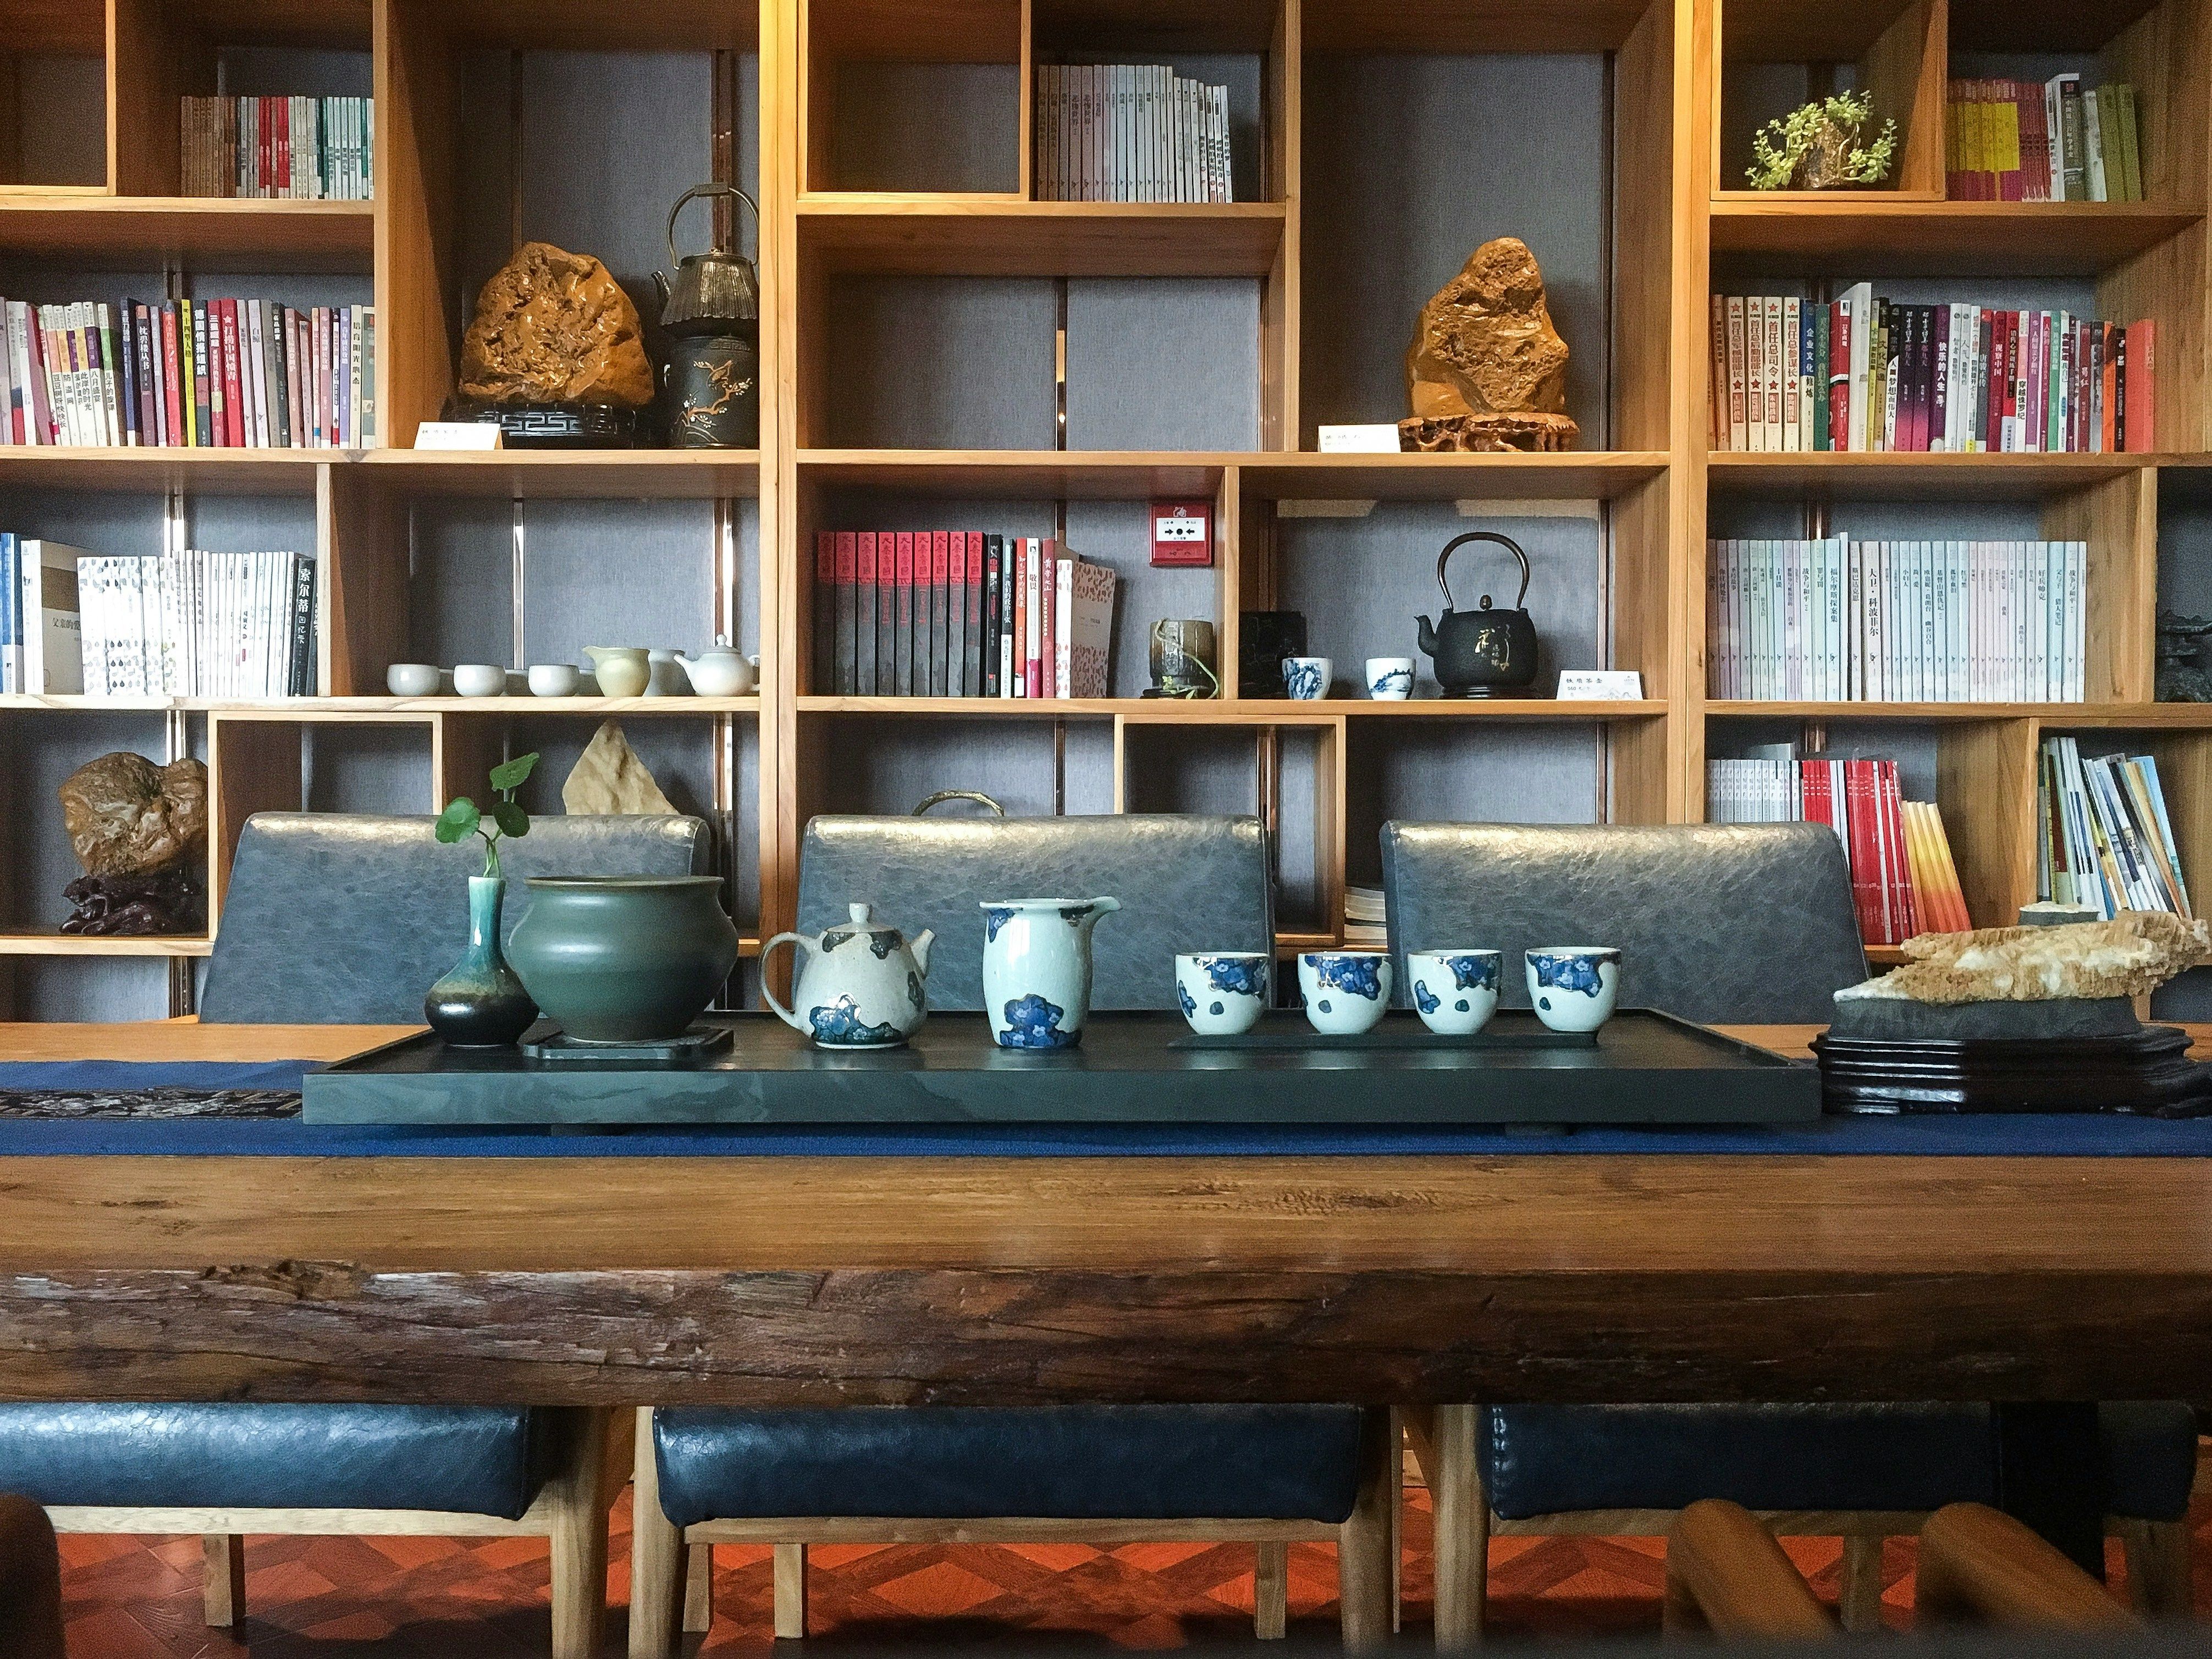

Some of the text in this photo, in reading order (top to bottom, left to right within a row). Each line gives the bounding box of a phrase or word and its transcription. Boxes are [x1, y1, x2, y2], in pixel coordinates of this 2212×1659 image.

[1768, 321, 1779, 377] 首任总司令
[1788, 321, 1797, 378] 首任总参谋长
[81, 373, 91, 410] 此岸的时光
[91, 370, 100, 402] 八月盛宴
[2017, 380, 2027, 420] 穿越侏罗纪
[1868, 568, 1879, 636] 大卫·科波菲尔
